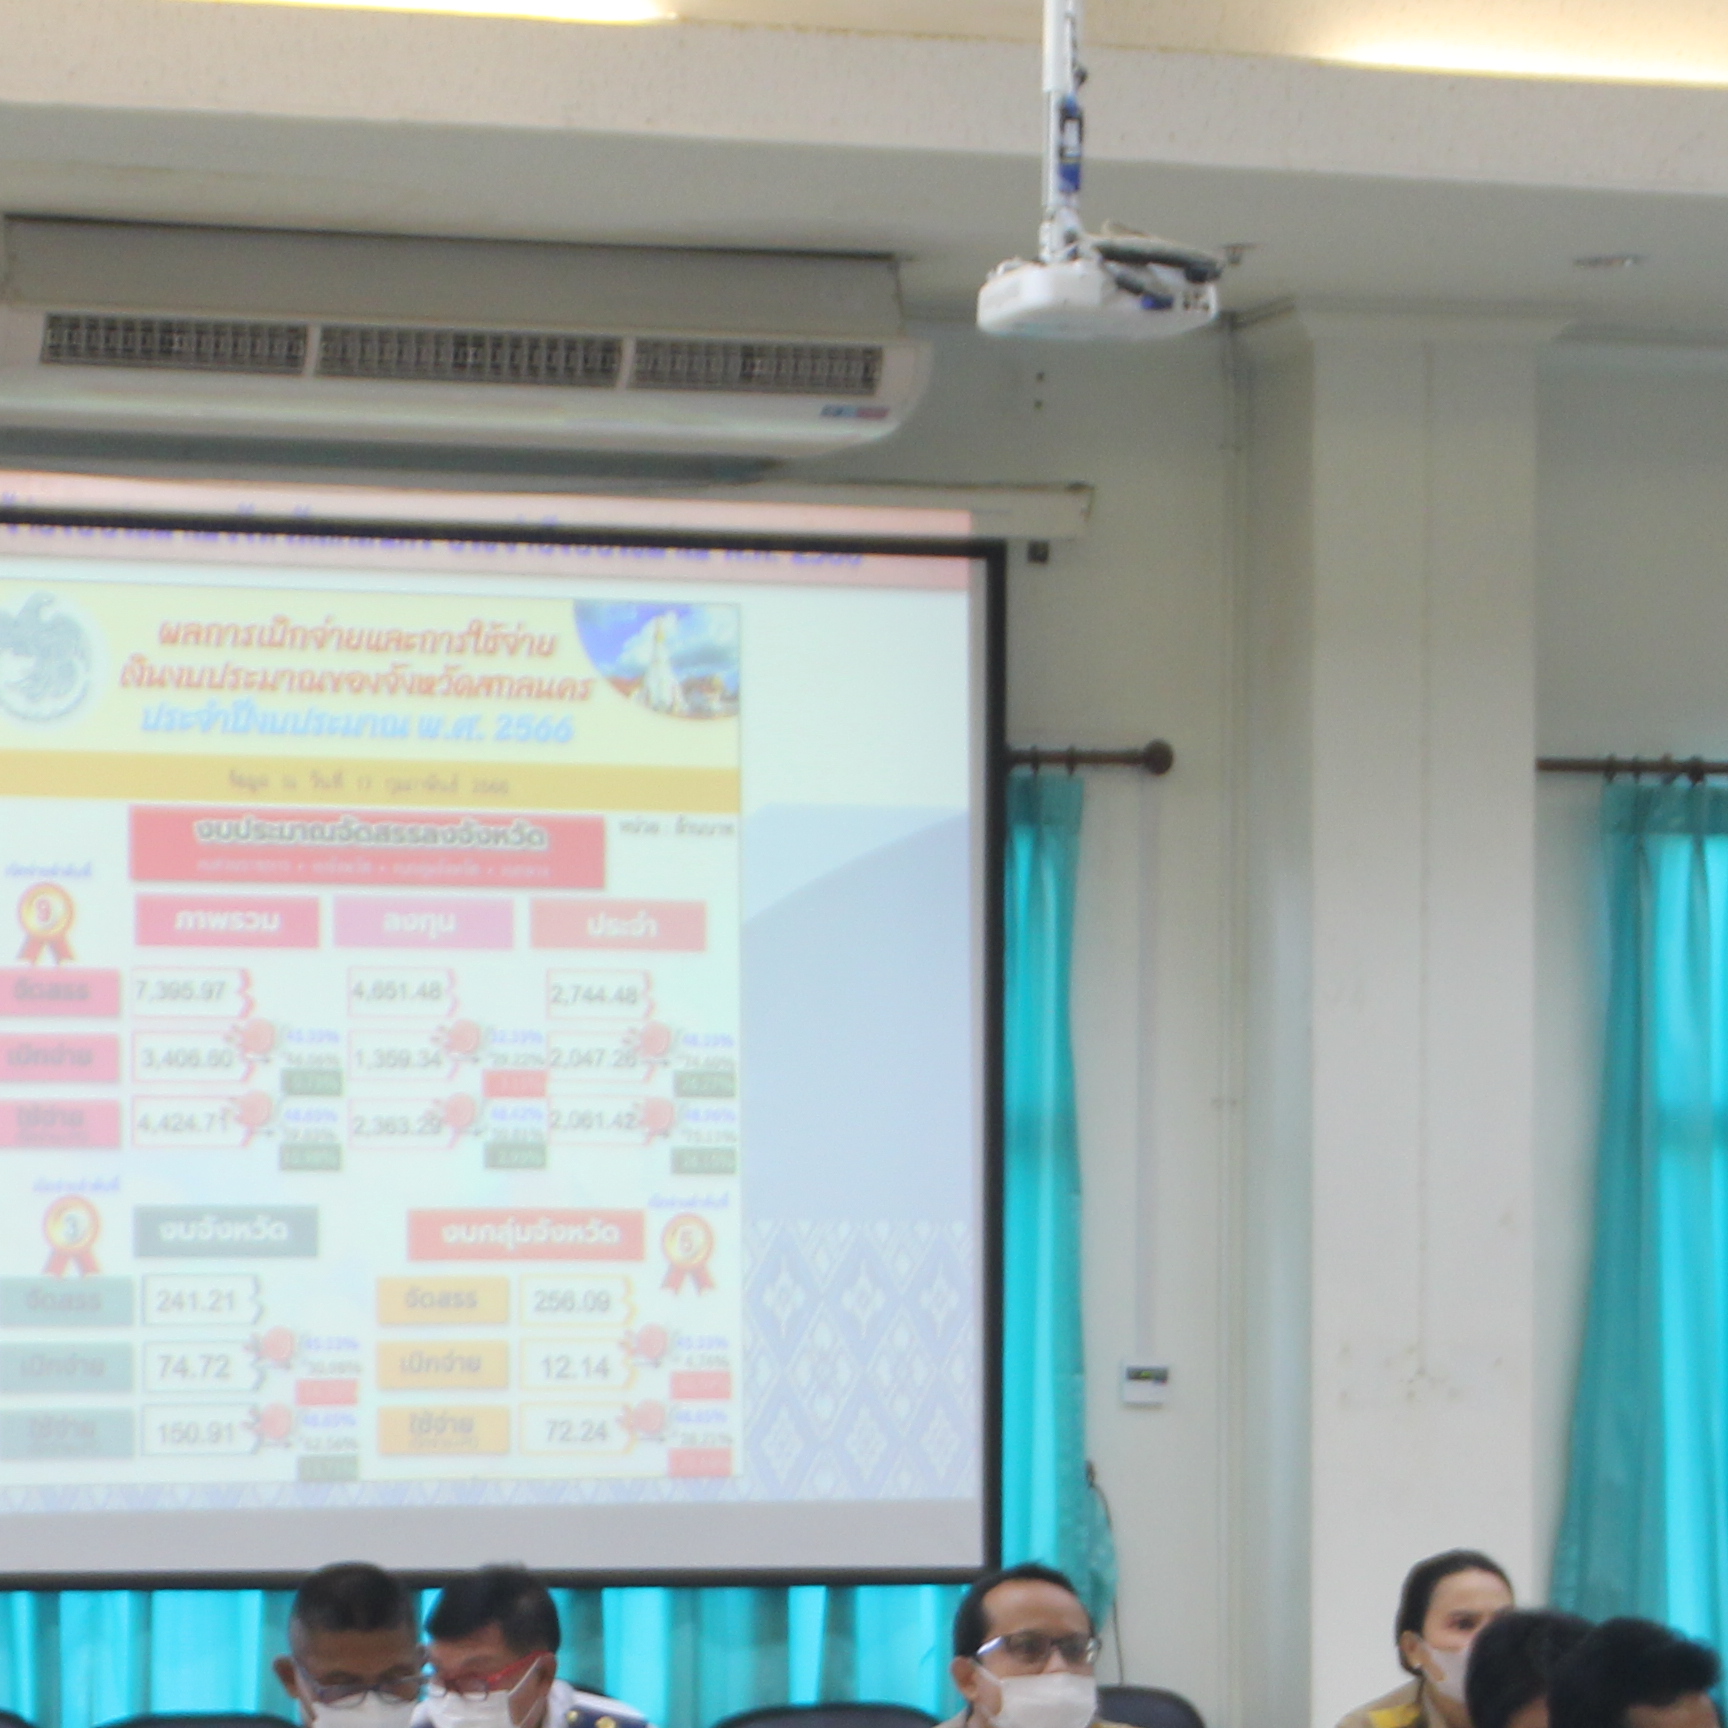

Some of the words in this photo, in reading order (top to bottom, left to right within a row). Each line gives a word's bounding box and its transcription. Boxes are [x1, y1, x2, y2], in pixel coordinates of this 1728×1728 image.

[493, 714, 576, 746] 2566
[155, 1288, 238, 1314] 241.21
[157, 1353, 232, 1381] 74.72
[541, 1355, 612, 1381] 12.14
[545, 1419, 609, 1444] 72.24
